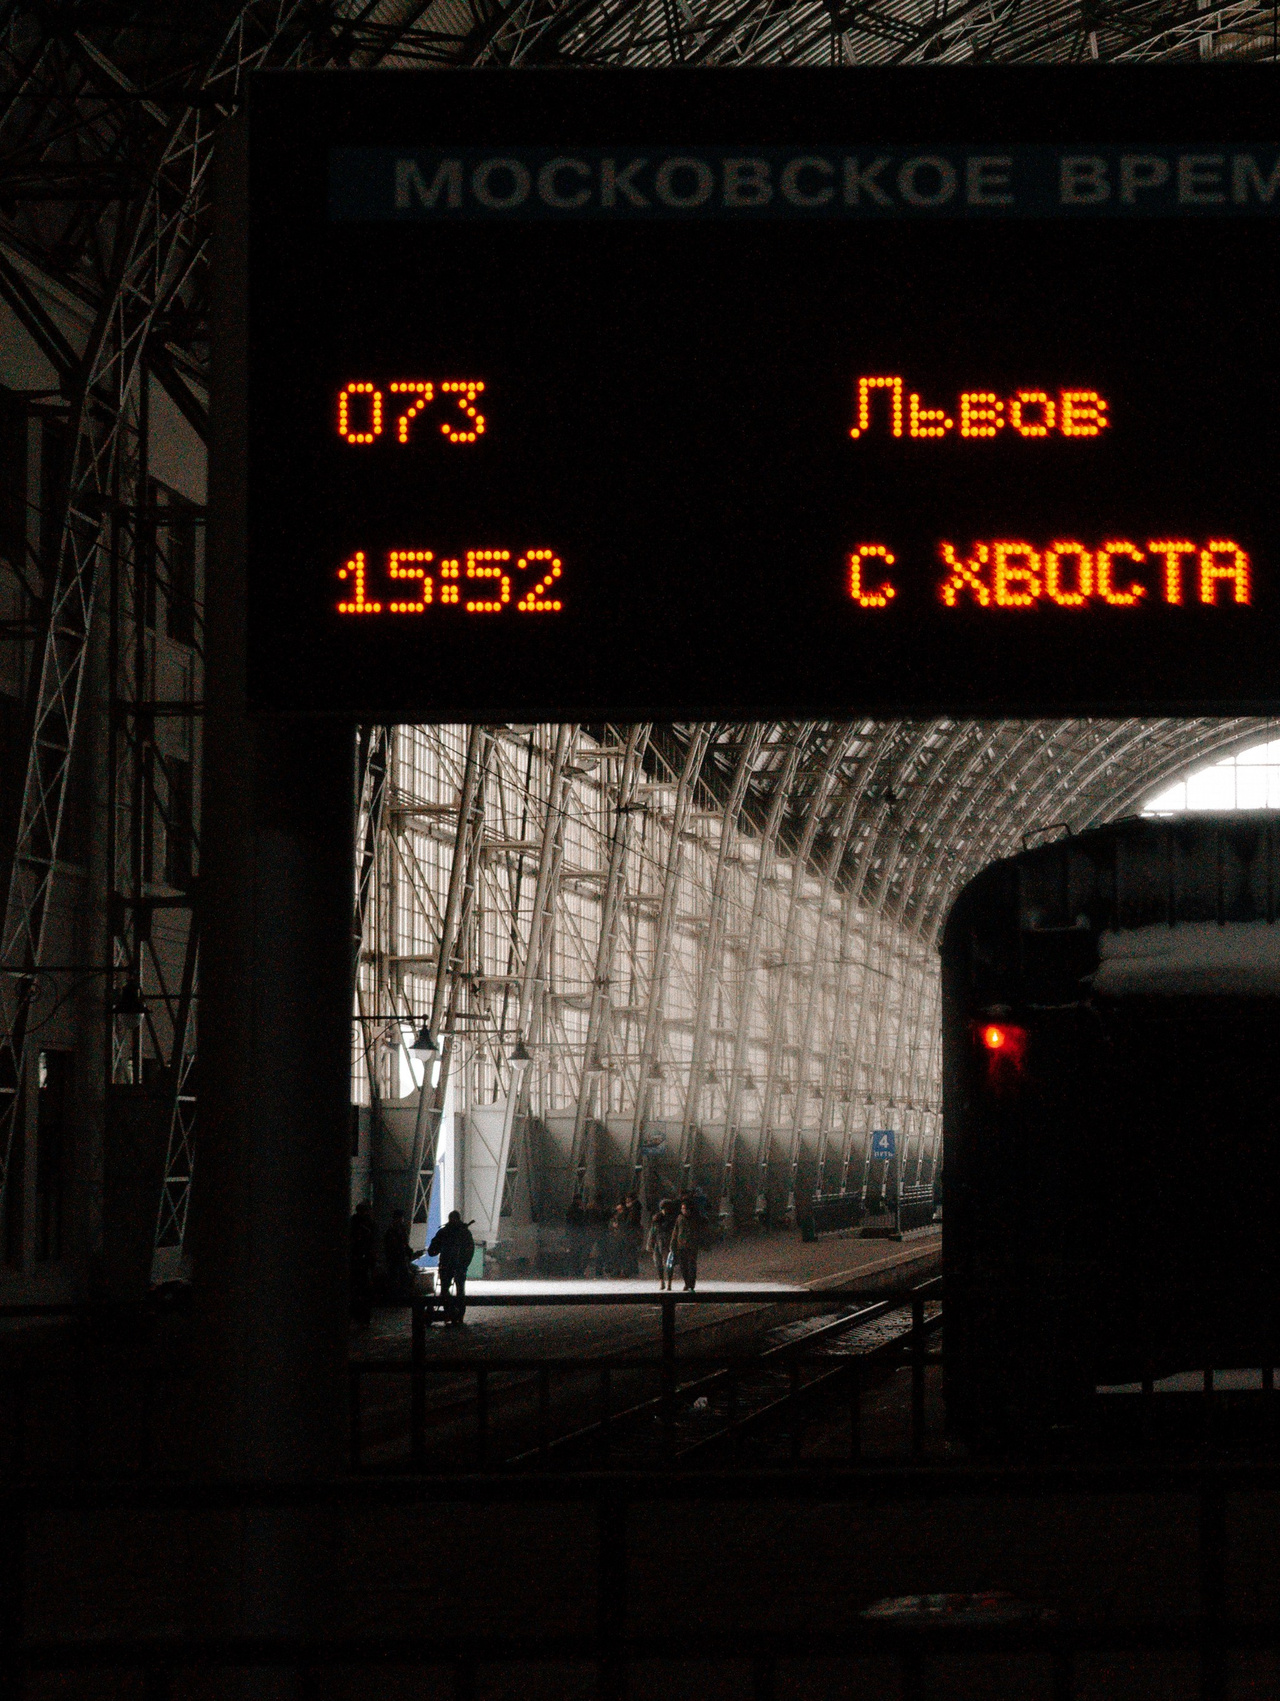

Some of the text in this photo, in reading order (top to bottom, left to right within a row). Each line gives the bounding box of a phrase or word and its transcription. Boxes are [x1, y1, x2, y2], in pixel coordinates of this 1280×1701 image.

[394, 155, 1014, 209] МОСКОВСКОЕ
[336, 379, 487, 445] 073
[848, 374, 1111, 441] Львов
[335, 547, 564, 616] 15:52
[938, 536, 1253, 611] ХВОСТА
[879, 1134, 890, 1149] 4
